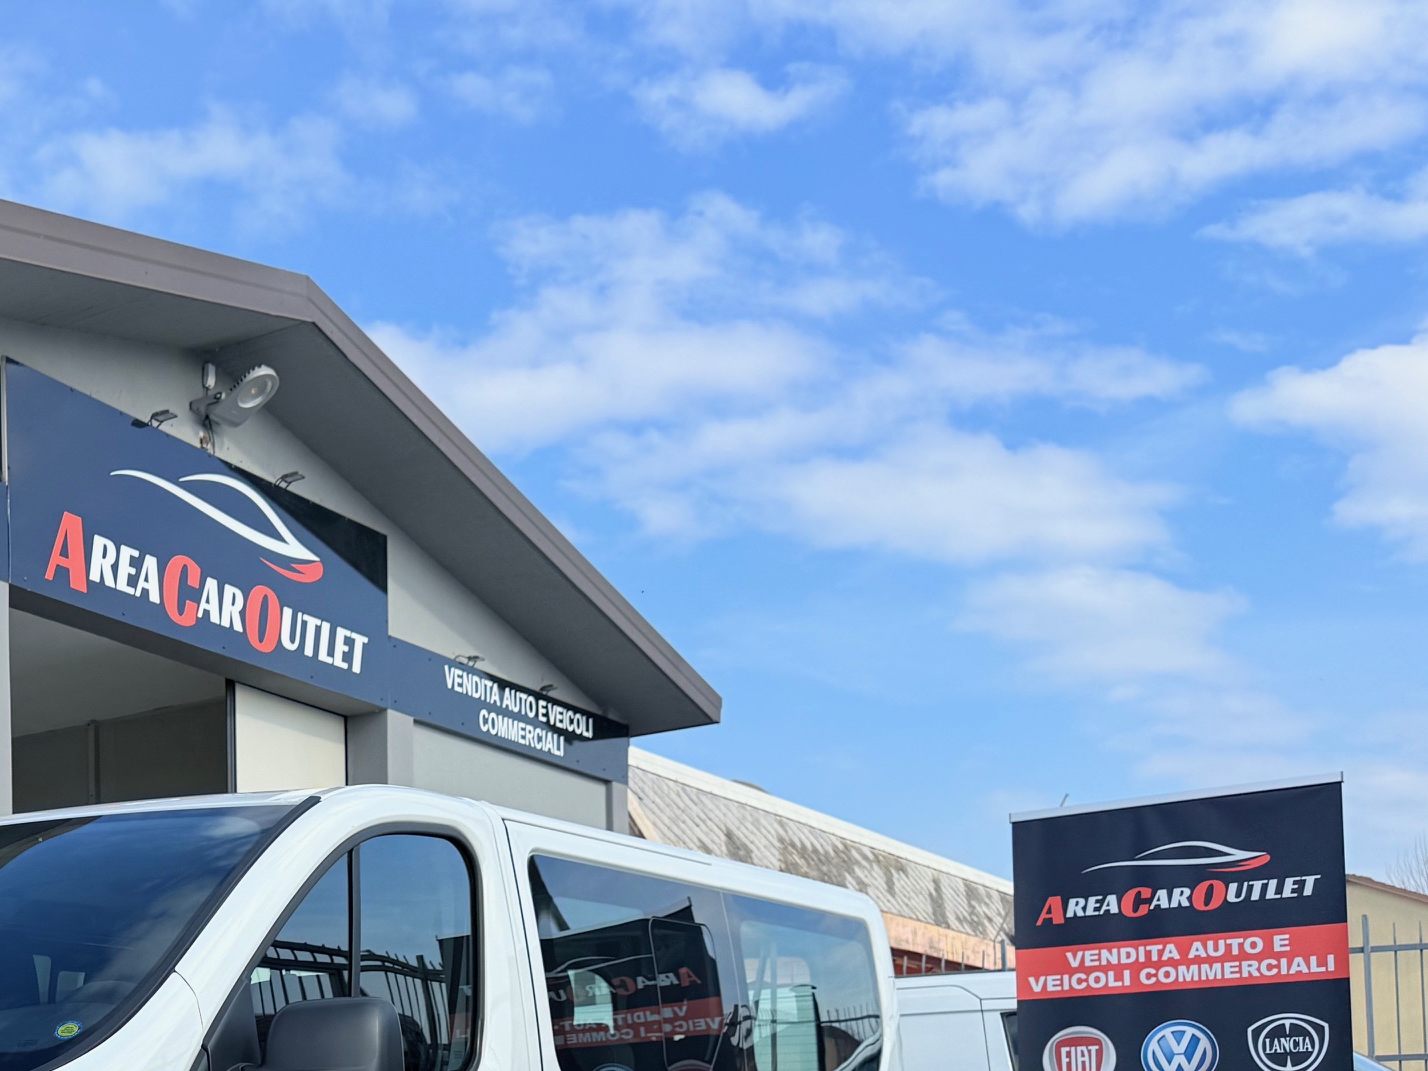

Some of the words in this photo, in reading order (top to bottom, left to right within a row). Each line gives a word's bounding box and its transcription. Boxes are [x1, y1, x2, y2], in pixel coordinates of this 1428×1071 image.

[444, 665, 500, 706] VENDITA
[502, 687, 537, 718] AUTO
[538, 700, 547, 723] E
[547, 702, 593, 739] VEICOLI
[479, 709, 565, 757] COMMERCIALI
[1065, 944, 1181, 968] VENDITA
[1188, 936, 1264, 959] AUTO
[1273, 934, 1290, 952] E
[1028, 970, 1130, 992] VEICOLI
[1139, 955, 1335, 985] COMMERCIALI
[1265, 1037, 1313, 1054] LANCIA
